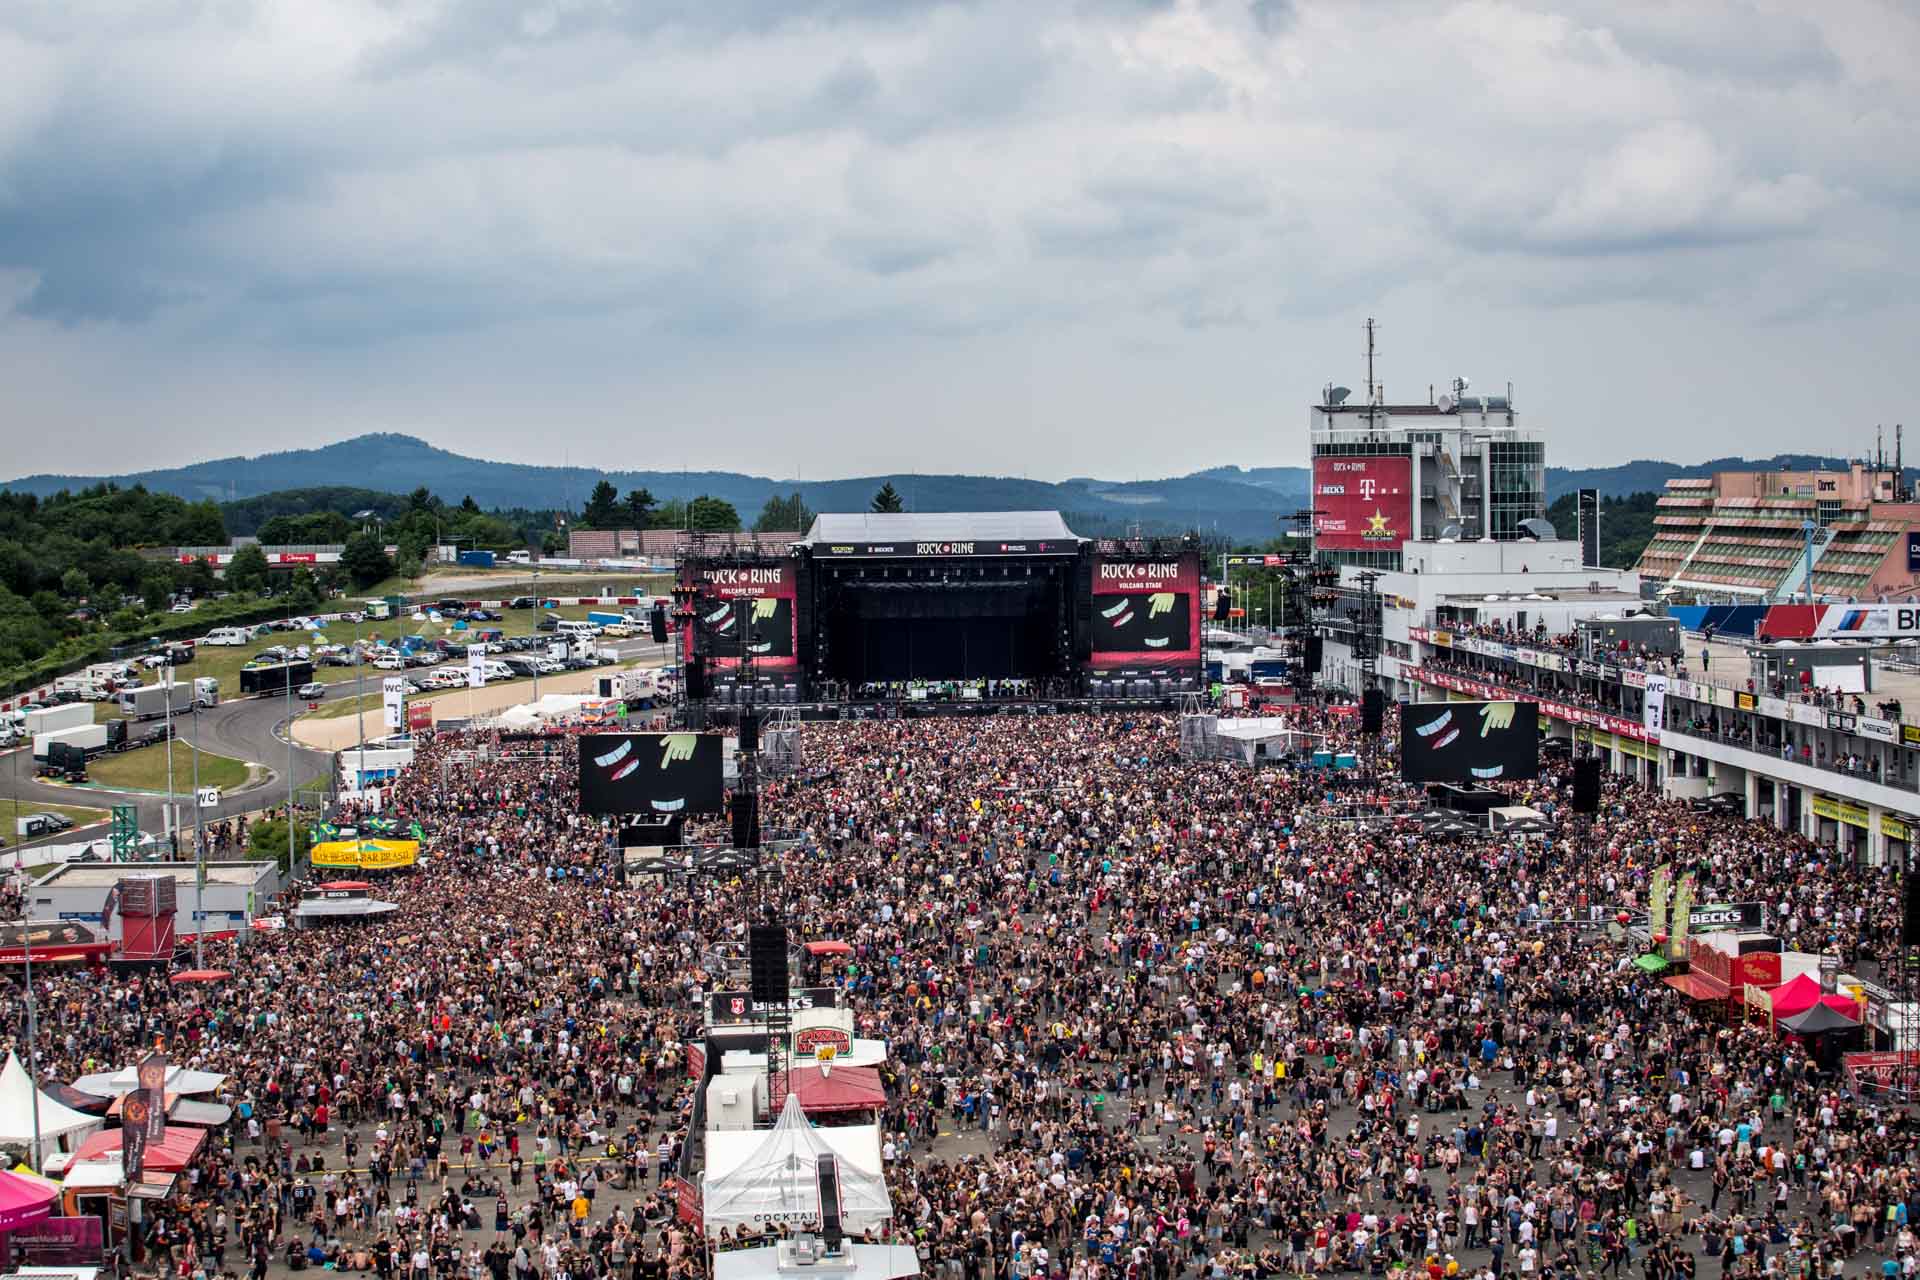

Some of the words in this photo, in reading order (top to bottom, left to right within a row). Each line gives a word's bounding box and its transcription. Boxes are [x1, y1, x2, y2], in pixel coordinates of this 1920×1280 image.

[916, 543, 944, 555] ROCK
[951, 542, 975, 554] RING
[750, 568, 782, 584] RING
[1101, 562, 1136, 579] ROCK
[1147, 562, 1179, 579] RING
[1145, 581, 1162, 589] STAGE
[470, 649, 485, 657] WC
[385, 684, 402, 693] WC
[1646, 682, 1665, 693] WC
[198, 792, 216, 803] WC
[1689, 910, 1742, 924] BECK'S
[801, 1030, 845, 1042] PIZZA
